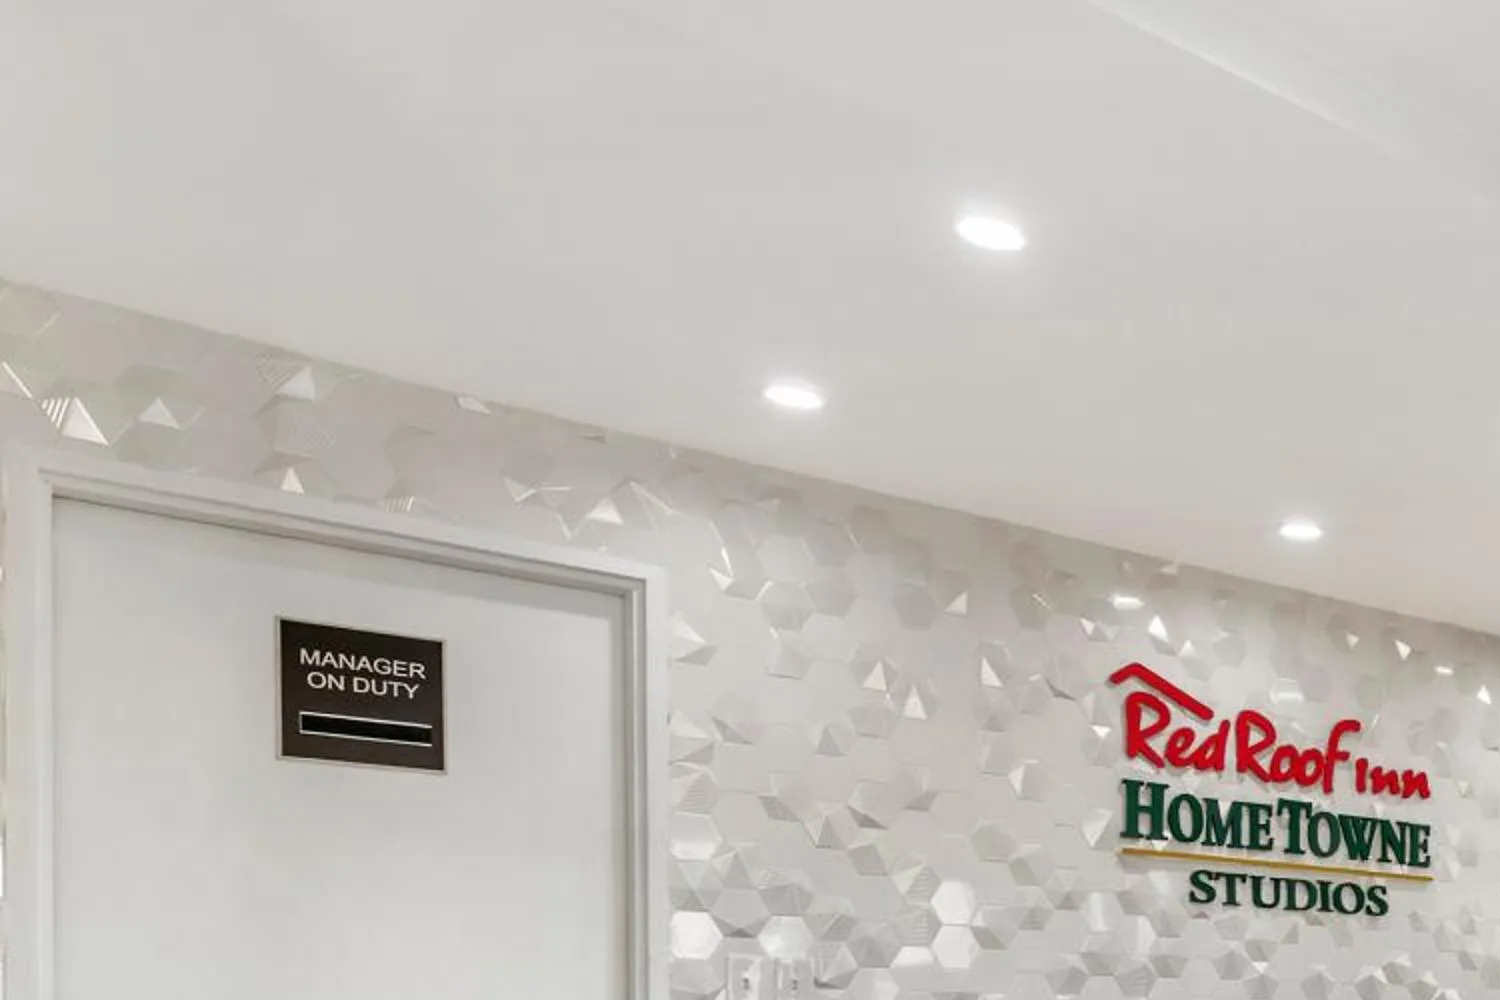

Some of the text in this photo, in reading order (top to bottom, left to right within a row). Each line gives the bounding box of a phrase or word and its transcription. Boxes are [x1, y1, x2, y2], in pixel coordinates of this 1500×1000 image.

[299, 647, 426, 681] MANAGER
[306, 671, 420, 700] ON DUTY
[1188, 869, 1390, 917] STUDIOS
